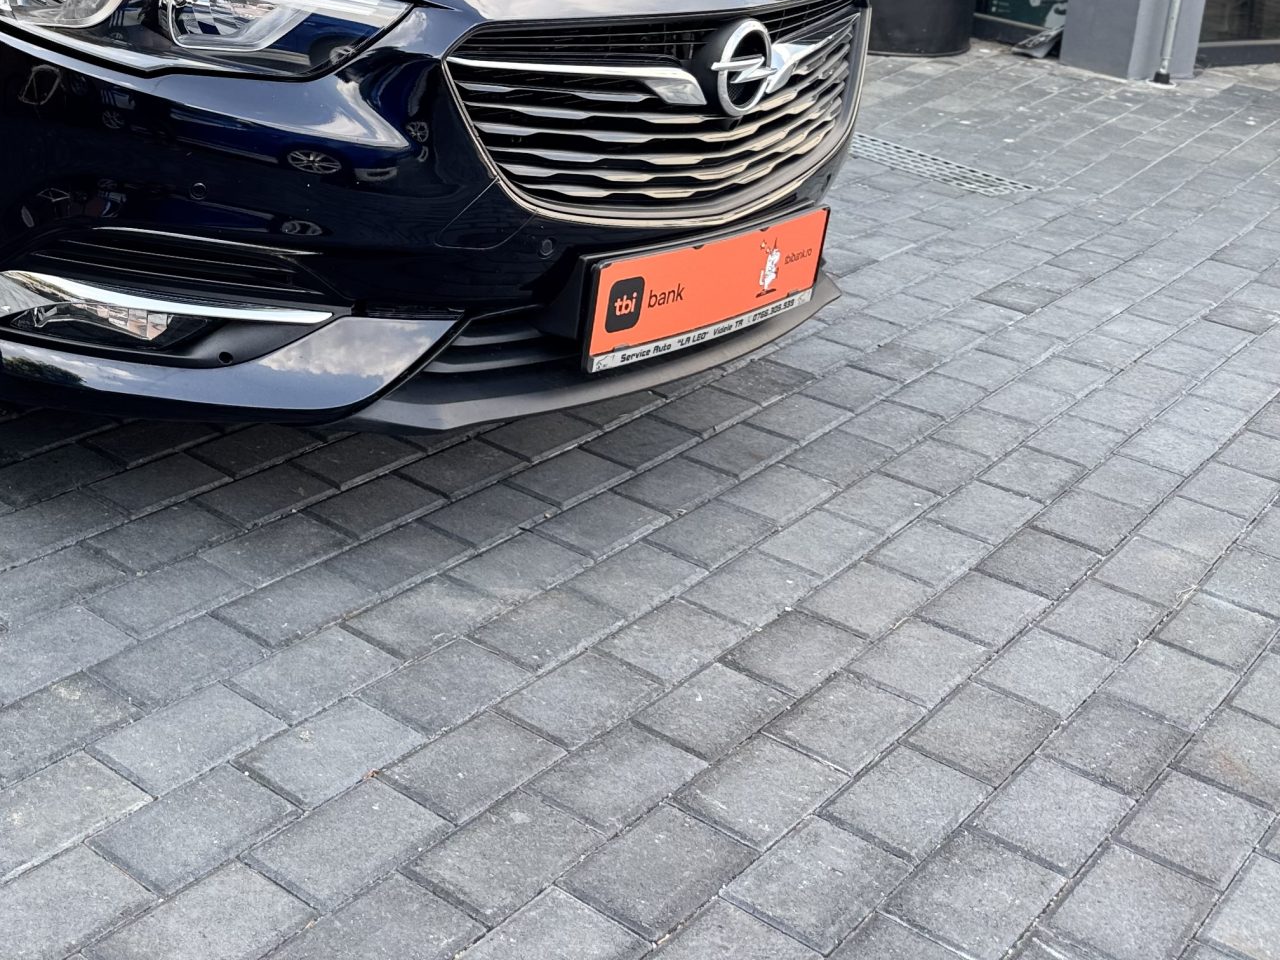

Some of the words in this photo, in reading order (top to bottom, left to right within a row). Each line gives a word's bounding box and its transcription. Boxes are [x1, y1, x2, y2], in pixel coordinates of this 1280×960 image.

[614, 291, 637, 316] tbi
[647, 283, 685, 308] bank
[620, 348, 651, 363] Service
[652, 343, 672, 355] Auto
